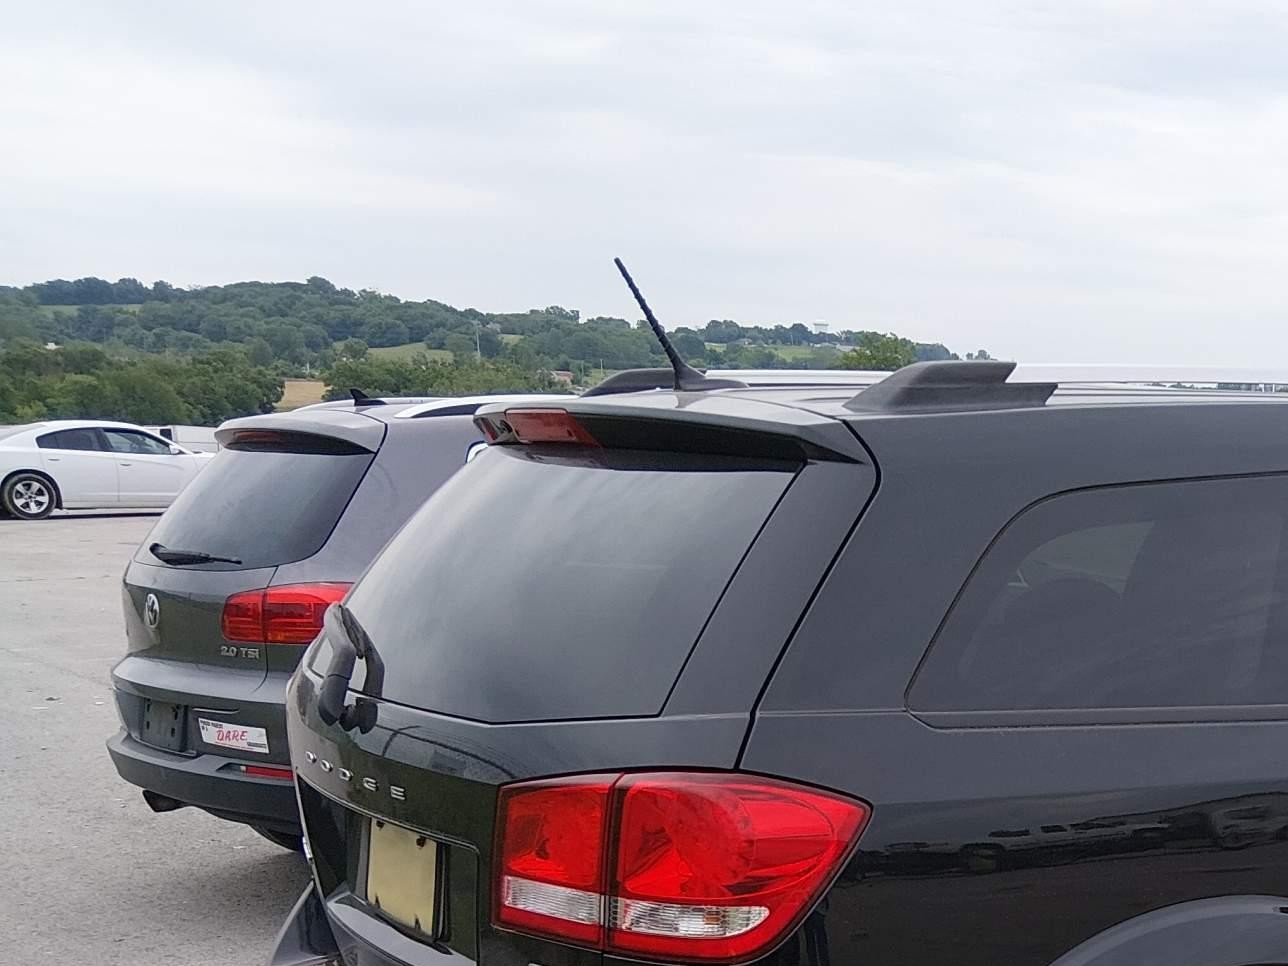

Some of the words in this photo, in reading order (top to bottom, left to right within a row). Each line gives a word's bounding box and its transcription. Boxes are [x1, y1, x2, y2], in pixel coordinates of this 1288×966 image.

[220, 645, 237, 657] 2.0
[240, 647, 259, 659] TSI
[216, 729, 248, 742] DARE
[305, 751, 406, 800] DODGE
